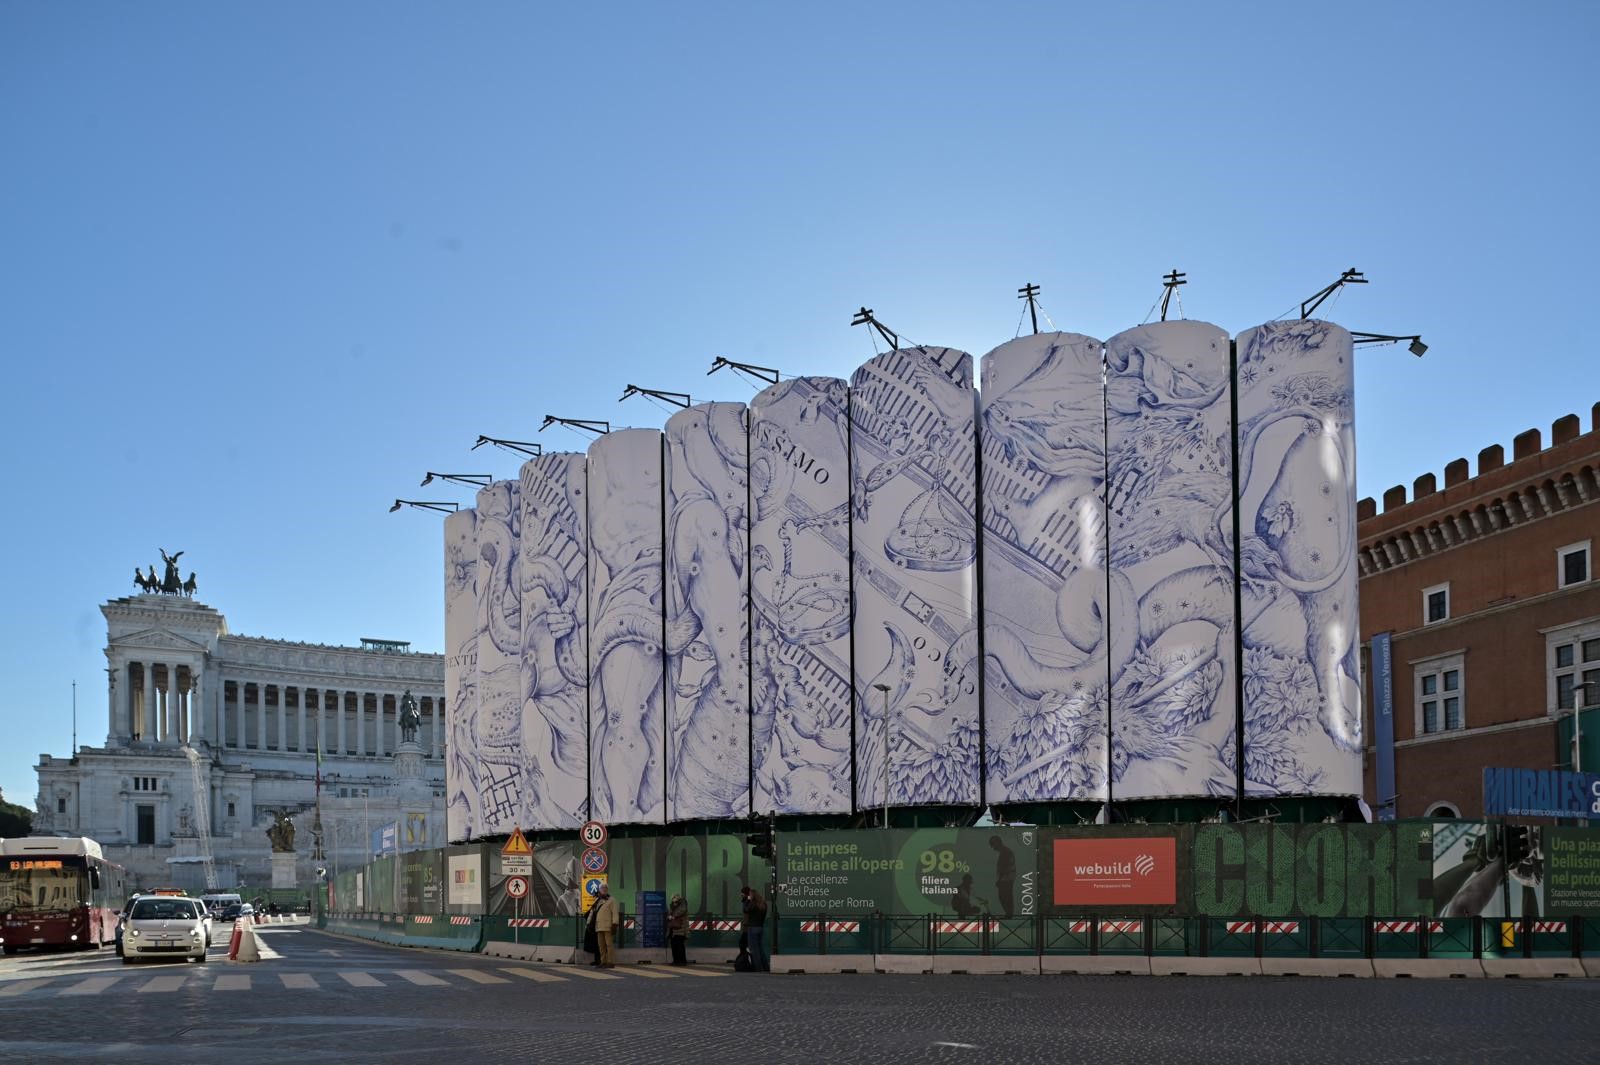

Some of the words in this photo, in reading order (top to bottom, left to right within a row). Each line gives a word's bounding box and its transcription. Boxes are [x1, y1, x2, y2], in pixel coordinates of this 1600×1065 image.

[1382, 638, 1390, 676] Venezia
[1382, 678, 1391, 715] Palazzo
[1484, 767, 1588, 816] MURALES
[587, 828, 601, 840] 30
[787, 843, 802, 855] Le
[804, 842, 858, 858] imprese
[1552, 837, 1576, 851] Una
[787, 857, 838, 871] italiane
[841, 856, 904, 874] all'opera
[919, 850, 970, 873] 98%
[1074, 862, 1132, 875] webuild
[1194, 823, 1434, 918] CUORE
[787, 875, 798, 884] Le
[799, 874, 848, 884] eccellenze
[921, 876, 950, 885] filiera
[1552, 870, 1569, 885] nel
[1571, 870, 1600, 888] profo
[787, 885, 801, 895] del
[803, 886, 830, 896] Paese
[921, 885, 959, 895] italiana
[1022, 871, 1033, 915] ROMA
[1551, 888, 1577, 897] Stazione
[787, 898, 826, 908] lavorano
[828, 899, 844, 909] per
[847, 897, 874, 908] Roma
